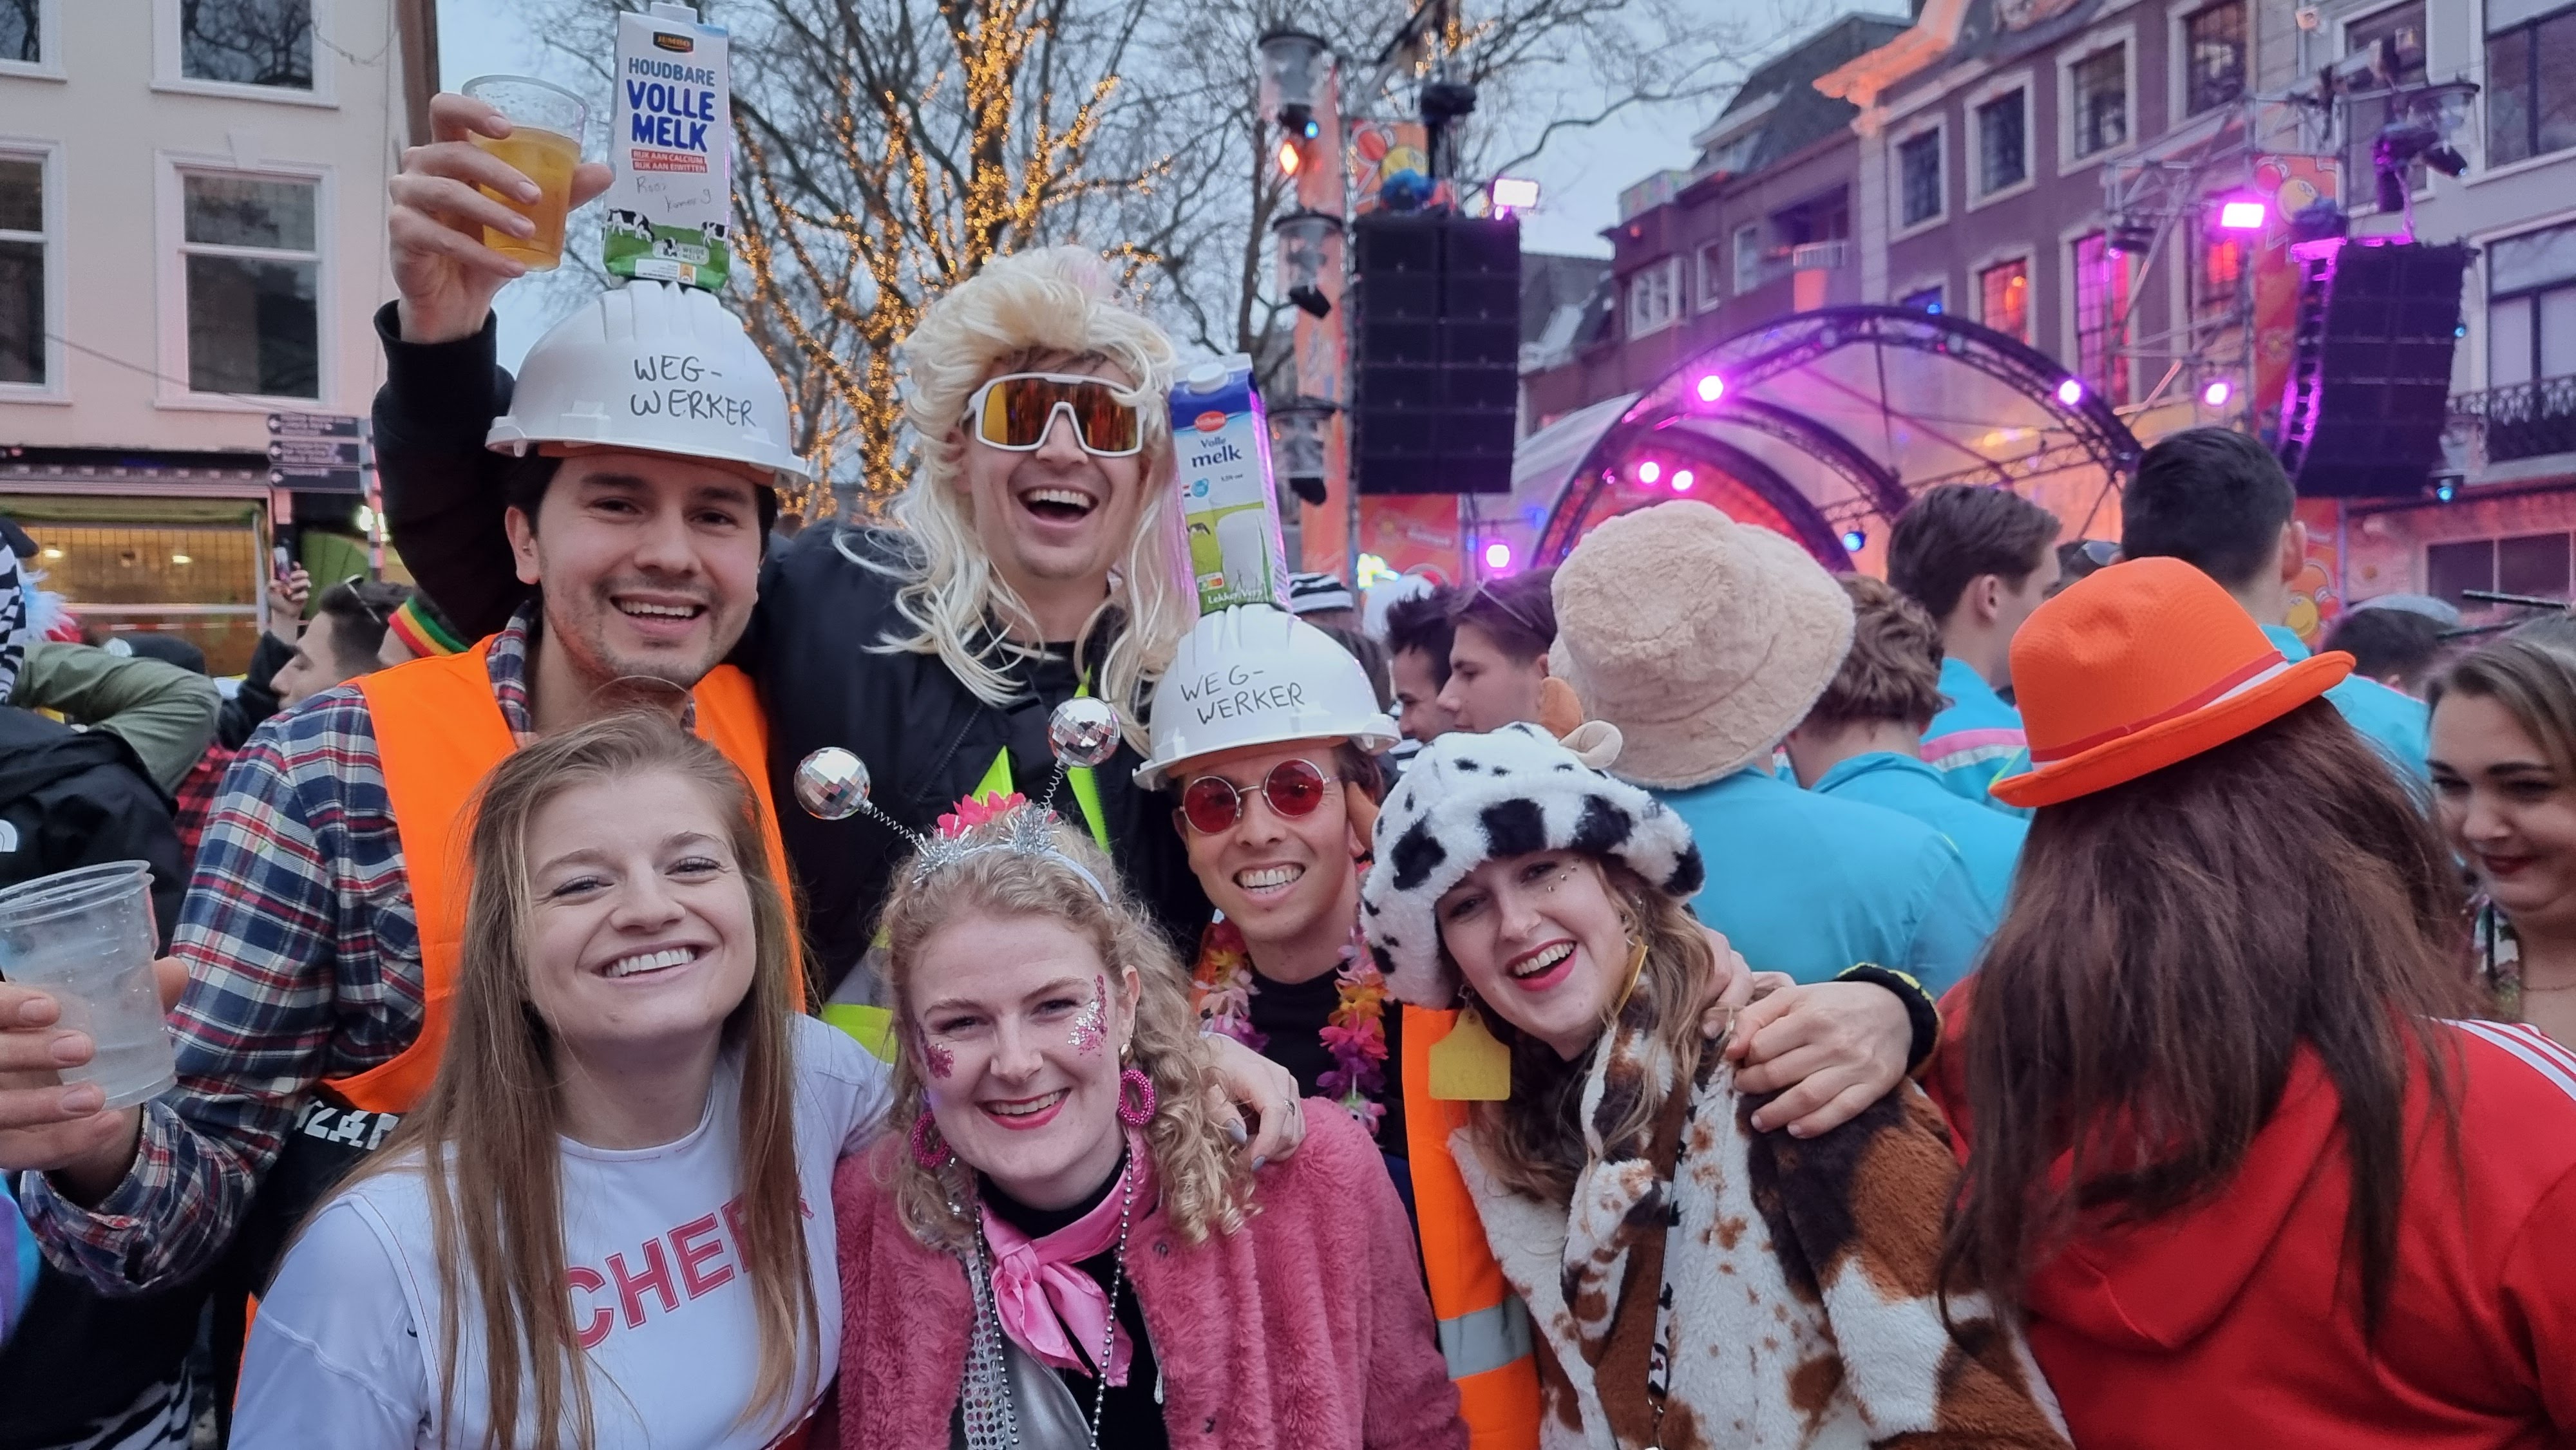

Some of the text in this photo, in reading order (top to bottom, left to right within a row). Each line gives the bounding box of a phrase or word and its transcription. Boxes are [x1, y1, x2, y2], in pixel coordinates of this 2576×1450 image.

[628, 57, 715, 88] HOUDBARE
[626, 79, 715, 122] VOLLE
[631, 112, 708, 153] MELK
[650, 151, 668, 161] AAN
[668, 153, 703, 164] CALCIUM
[652, 162, 669, 171] AAN
[634, 354, 723, 382] WEG-
[630, 389, 757, 427] WERKER
[1191, 444, 1243, 468] melk
[1200, 436, 1227, 449] Volle
[1180, 664, 1264, 701] WEG-
[1197, 682, 1305, 725] WERKER
[558, 1186, 814, 1350] CHE
